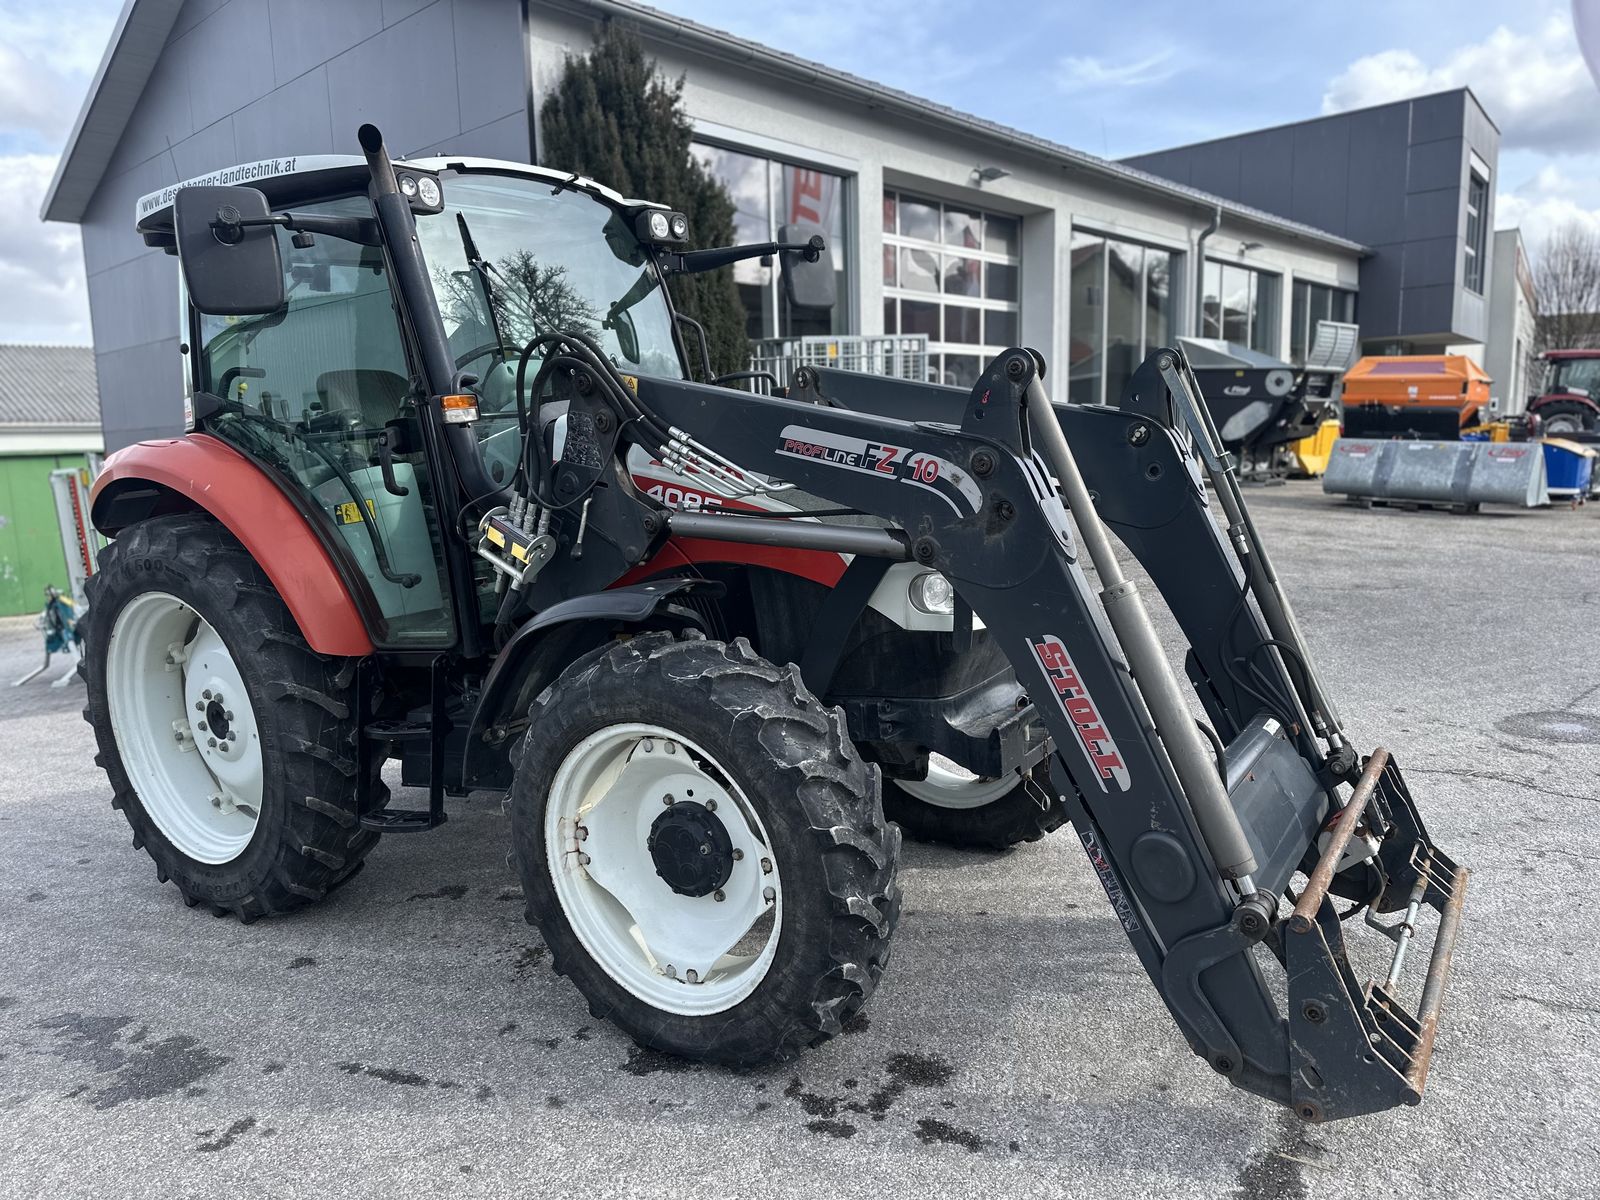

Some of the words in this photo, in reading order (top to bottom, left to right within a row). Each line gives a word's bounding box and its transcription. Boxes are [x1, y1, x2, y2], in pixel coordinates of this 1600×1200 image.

[142, 157, 297, 213] www.desrger-landtechnik.at
[859, 443, 899, 474] FZ
[913, 457, 939, 484] 10
[1036, 641, 1125, 779] STOLL
